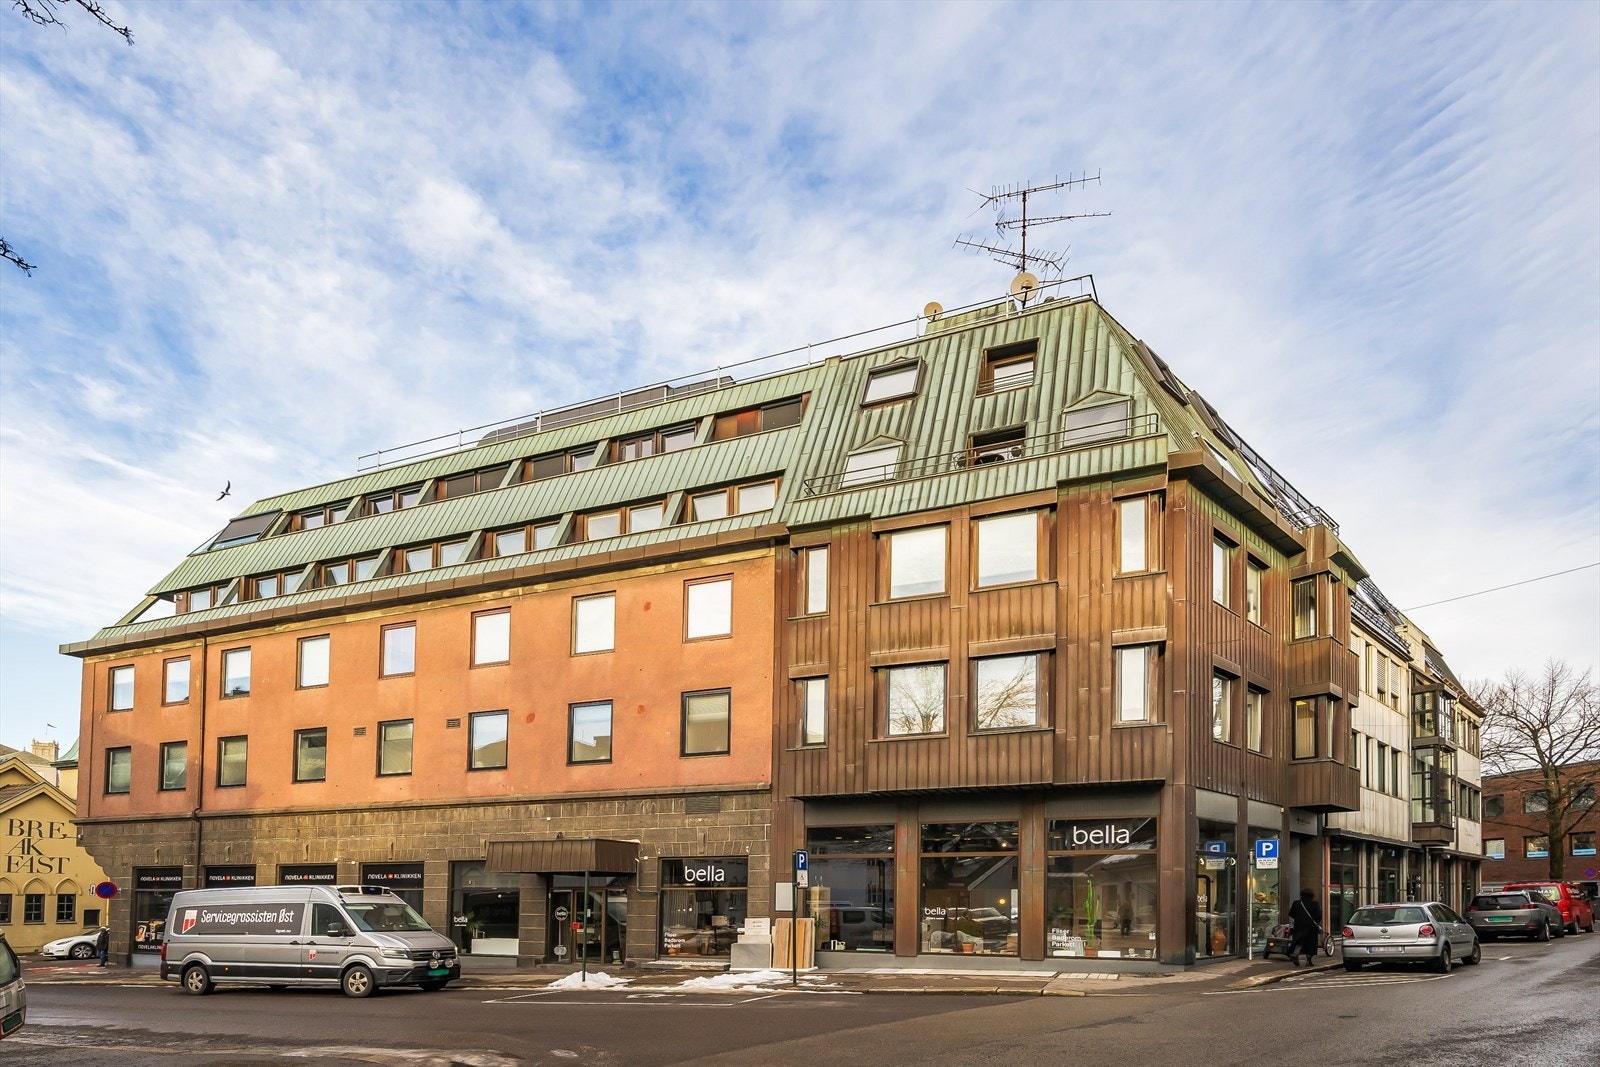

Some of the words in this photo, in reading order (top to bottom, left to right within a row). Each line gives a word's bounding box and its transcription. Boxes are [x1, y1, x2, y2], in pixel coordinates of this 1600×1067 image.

[1073, 825, 1130, 844] bella
[1261, 842, 1273, 856] P
[799, 854, 805, 868] P
[684, 865, 725, 882] bella
[201, 910, 277, 925] Servicegrossisten
[278, 908, 294, 924] Øst
[924, 907, 946, 915] bella
